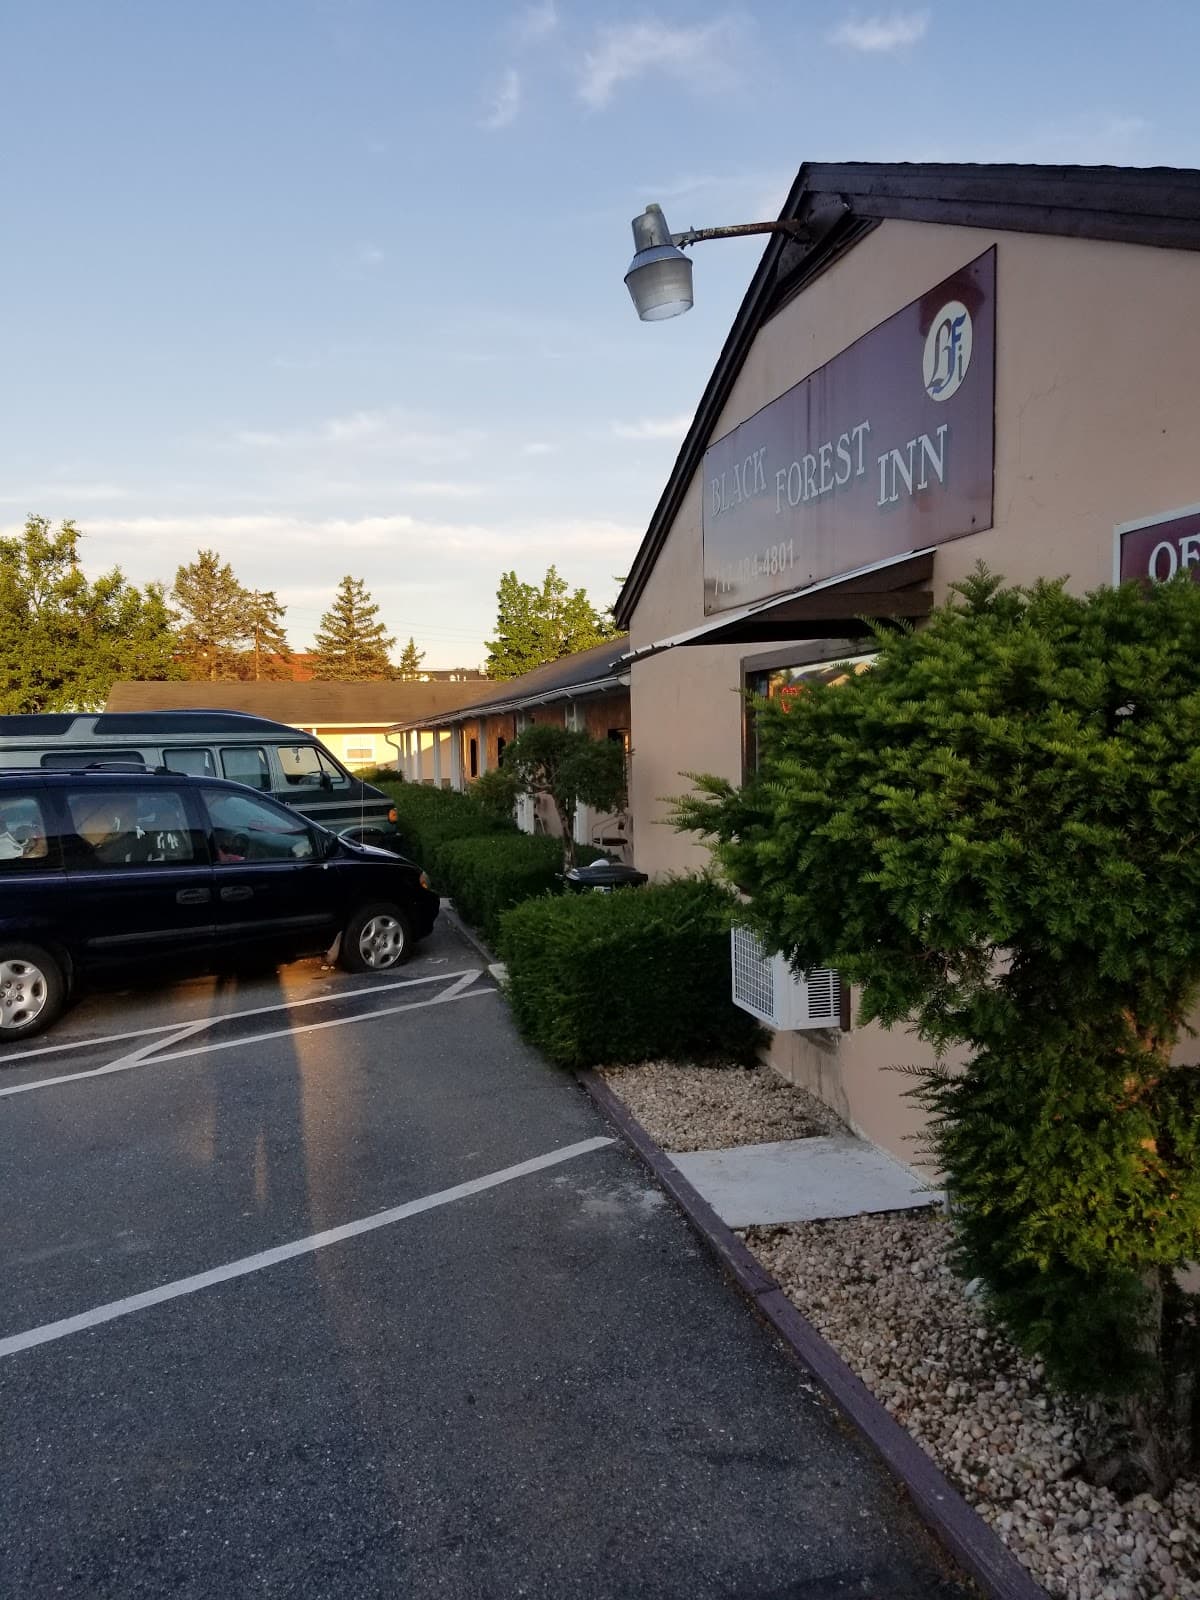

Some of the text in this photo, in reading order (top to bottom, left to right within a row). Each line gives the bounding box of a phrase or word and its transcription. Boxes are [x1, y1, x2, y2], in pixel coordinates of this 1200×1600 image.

[710, 419, 948, 517] BLACK FOREST INN
